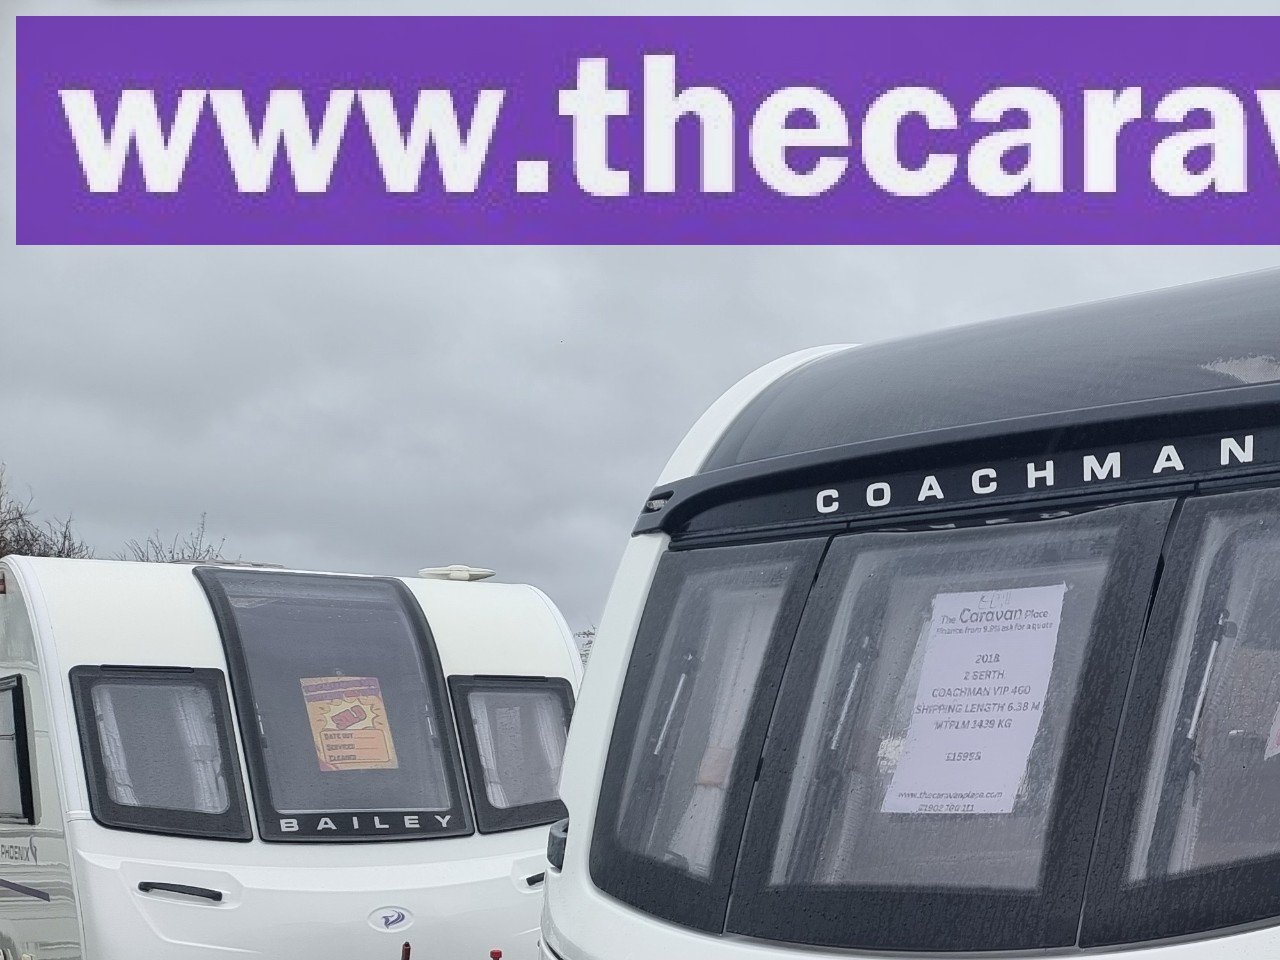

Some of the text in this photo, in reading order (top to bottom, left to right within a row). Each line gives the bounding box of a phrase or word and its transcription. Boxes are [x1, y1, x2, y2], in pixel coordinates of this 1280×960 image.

[815, 434, 1255, 514] COACHMAN
[959, 607, 1023, 624] Caravan
[1024, 609, 1049, 620] Place
[931, 687, 991, 698] COACHMAN
[993, 686, 1009, 696] VIP
[915, 704, 963, 715] SHIPPING
[964, 702, 1006, 713] LENGTH
[997, 718, 1013, 729] KG
[279, 815, 451, 832] BAILEY
